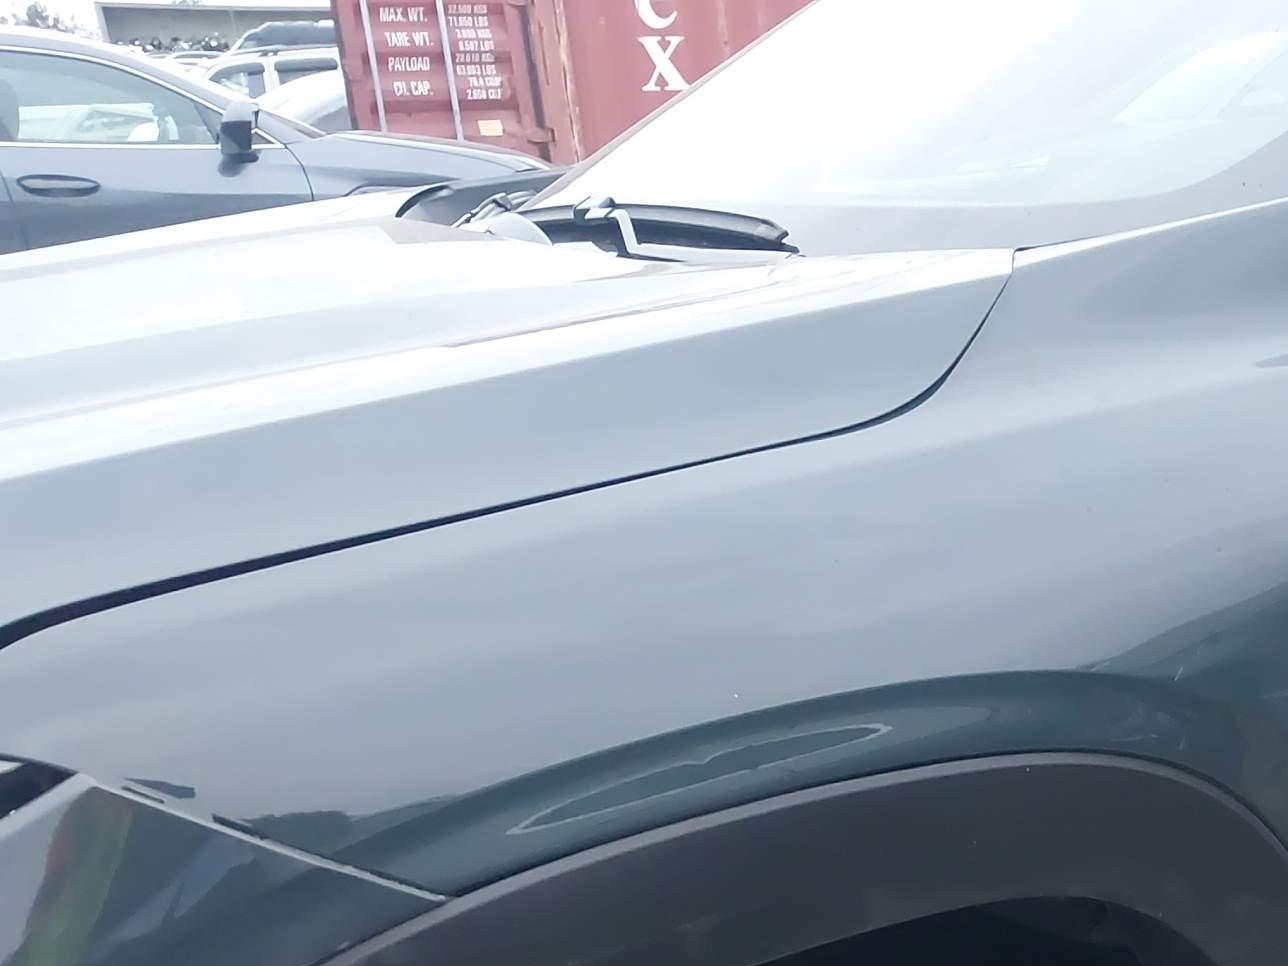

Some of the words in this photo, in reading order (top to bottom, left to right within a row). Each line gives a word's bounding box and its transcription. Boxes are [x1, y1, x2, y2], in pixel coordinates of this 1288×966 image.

[379, 7, 406, 22] MAX.
[407, 7, 428, 22] WT.
[384, 31, 410, 47] TARE
[411, 31, 434, 47] WT.
[388, 56, 430, 72] PAYLOAD
[410, 80, 434, 96] CAP.
